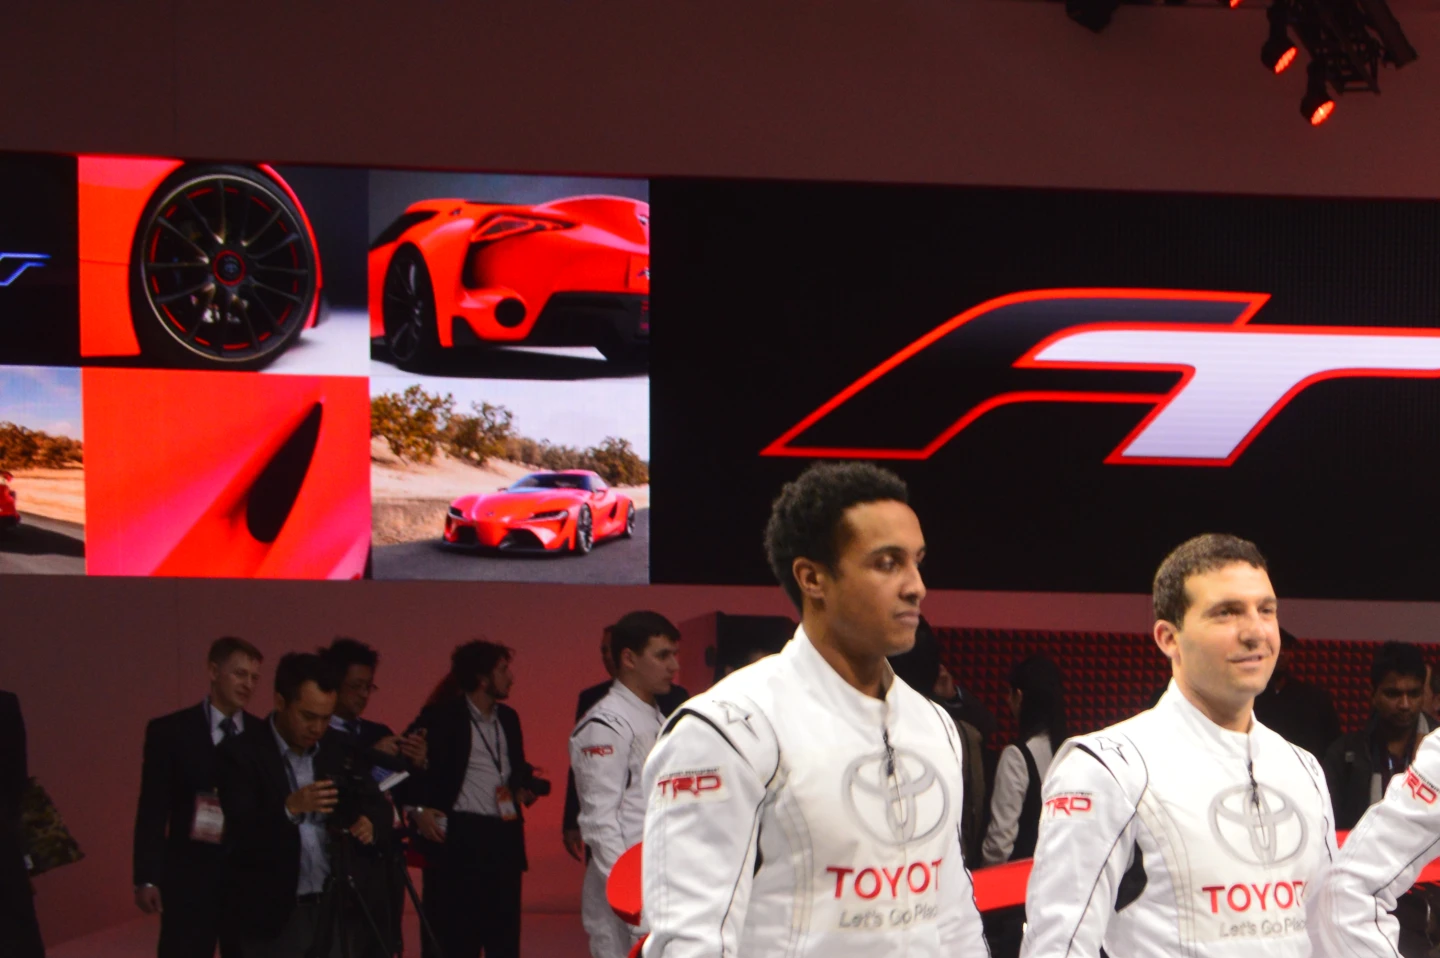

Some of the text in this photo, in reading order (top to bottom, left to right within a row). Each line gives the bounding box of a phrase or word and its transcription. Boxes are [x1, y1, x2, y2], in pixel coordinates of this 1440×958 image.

[657, 774, 722, 799] TRD
[1045, 796, 1092, 817] TRD
[826, 857, 942, 901] TOYOT
[1201, 880, 1308, 914] TOYOT
[889, 906, 912, 927] Go
[1261, 919, 1283, 936] Go
